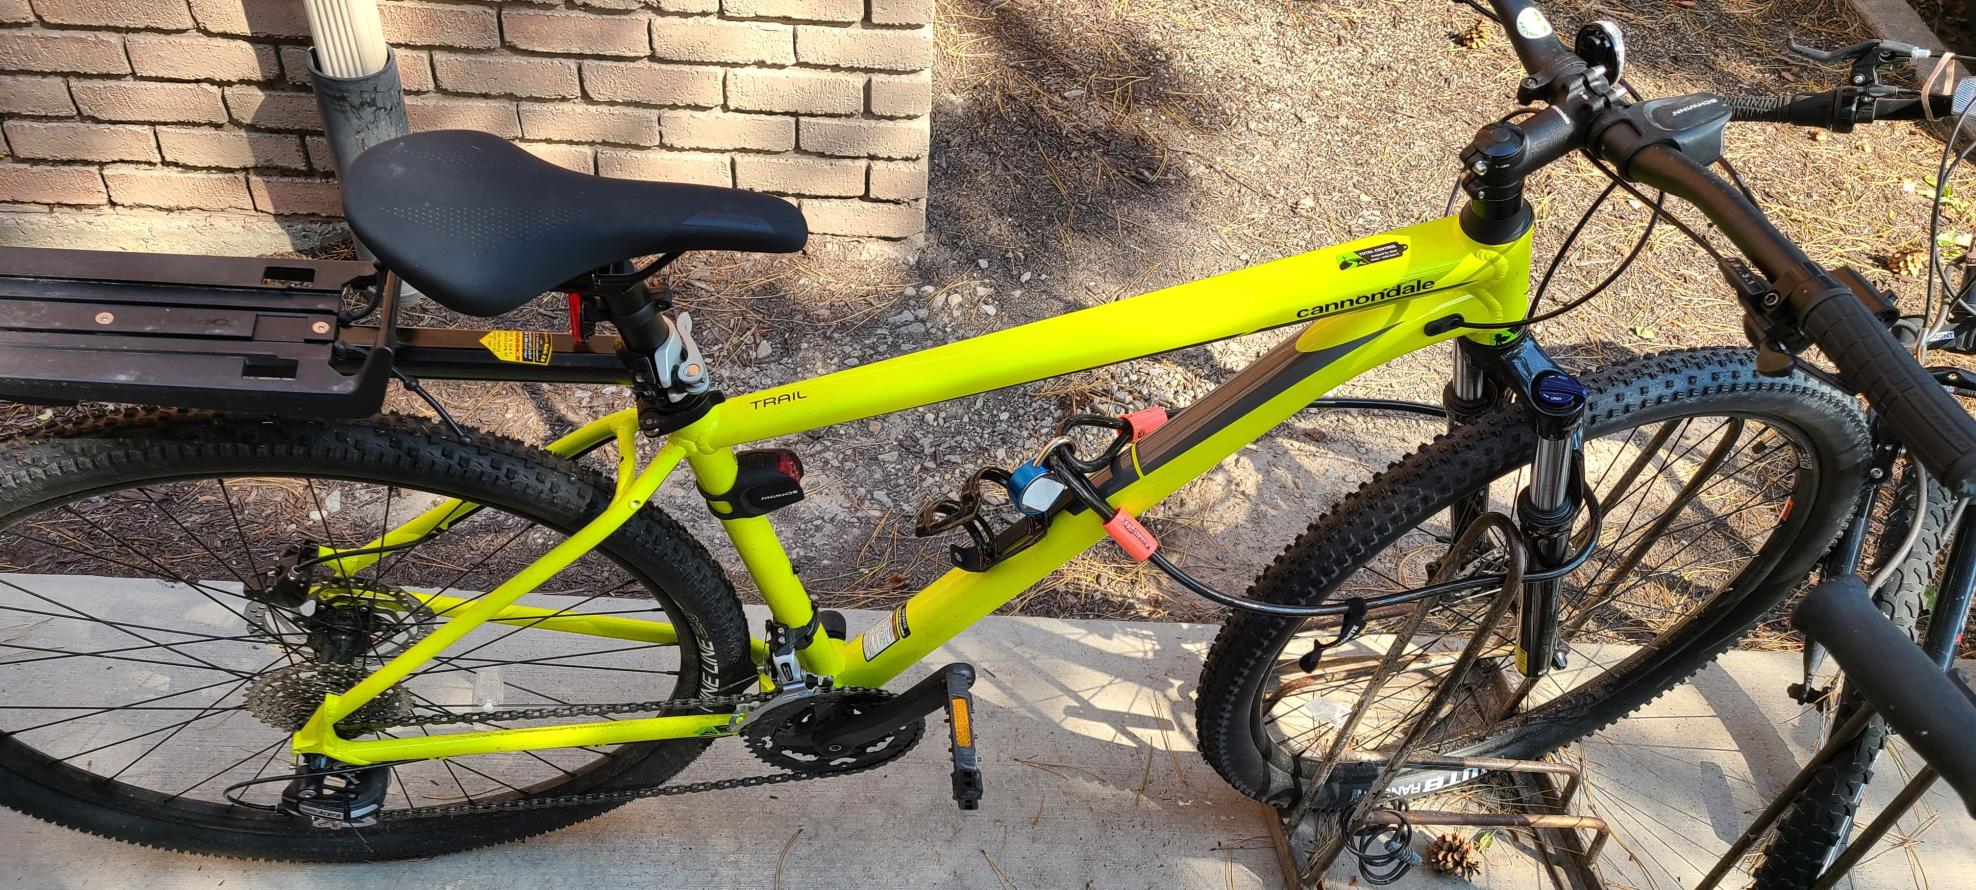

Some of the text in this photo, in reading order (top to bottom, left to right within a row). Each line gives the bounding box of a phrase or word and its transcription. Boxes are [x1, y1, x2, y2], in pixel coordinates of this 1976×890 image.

[1296, 279, 1436, 319] cannondale
[750, 391, 807, 410] TRAIL
[696, 635, 719, 675] LINE
